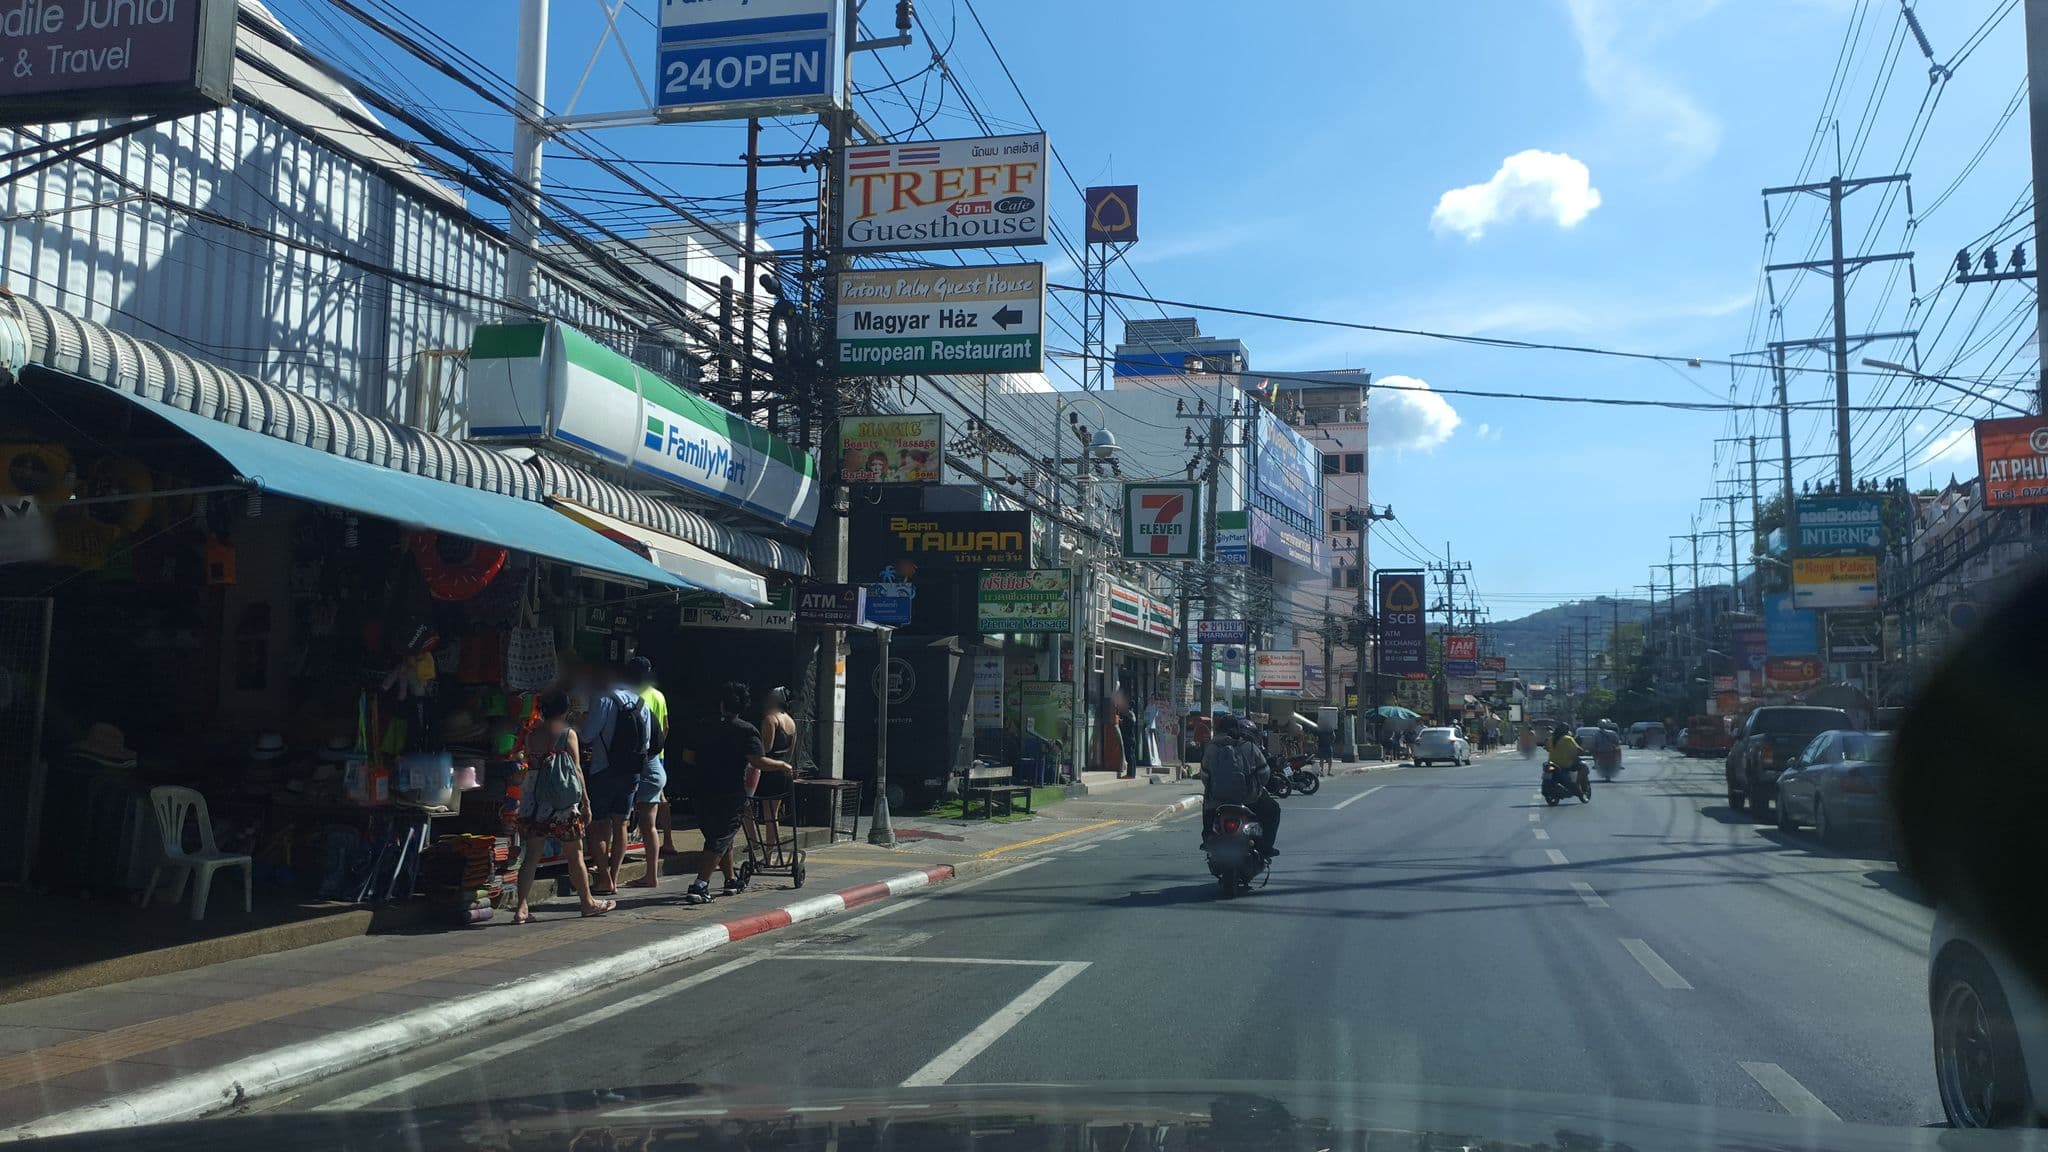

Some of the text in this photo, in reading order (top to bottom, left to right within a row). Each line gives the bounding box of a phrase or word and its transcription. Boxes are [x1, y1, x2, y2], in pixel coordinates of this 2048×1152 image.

[14, 38, 131, 77] & Travel
[665, 51, 819, 93] 24OPEN
[849, 162, 1038, 220] TREFF
[955, 203, 970, 215] 50
[997, 198, 1031, 213] Cafe
[848, 214, 1036, 243] Guesthouse
[842, 272, 1033, 301] Patong Palm Guest House
[854, 311, 930, 334] Magyar
[840, 339, 1031, 365] European Restaurant
[858, 422, 922, 437] MAGIC
[894, 438, 936, 449] Massage
[667, 424, 746, 485] FamilyMart
[1990, 459, 2008, 482] AT
[1140, 523, 1182, 535] ELEVEN
[1142, 494, 1183, 554] 7
[898, 531, 1023, 551] TAWAN
[1801, 526, 1879, 545] INTERNET
[801, 594, 836, 608] ATM
[765, 614, 788, 625] ATM
[980, 617, 1068, 629] Premier Massage
[1388, 613, 1416, 624] SCB
